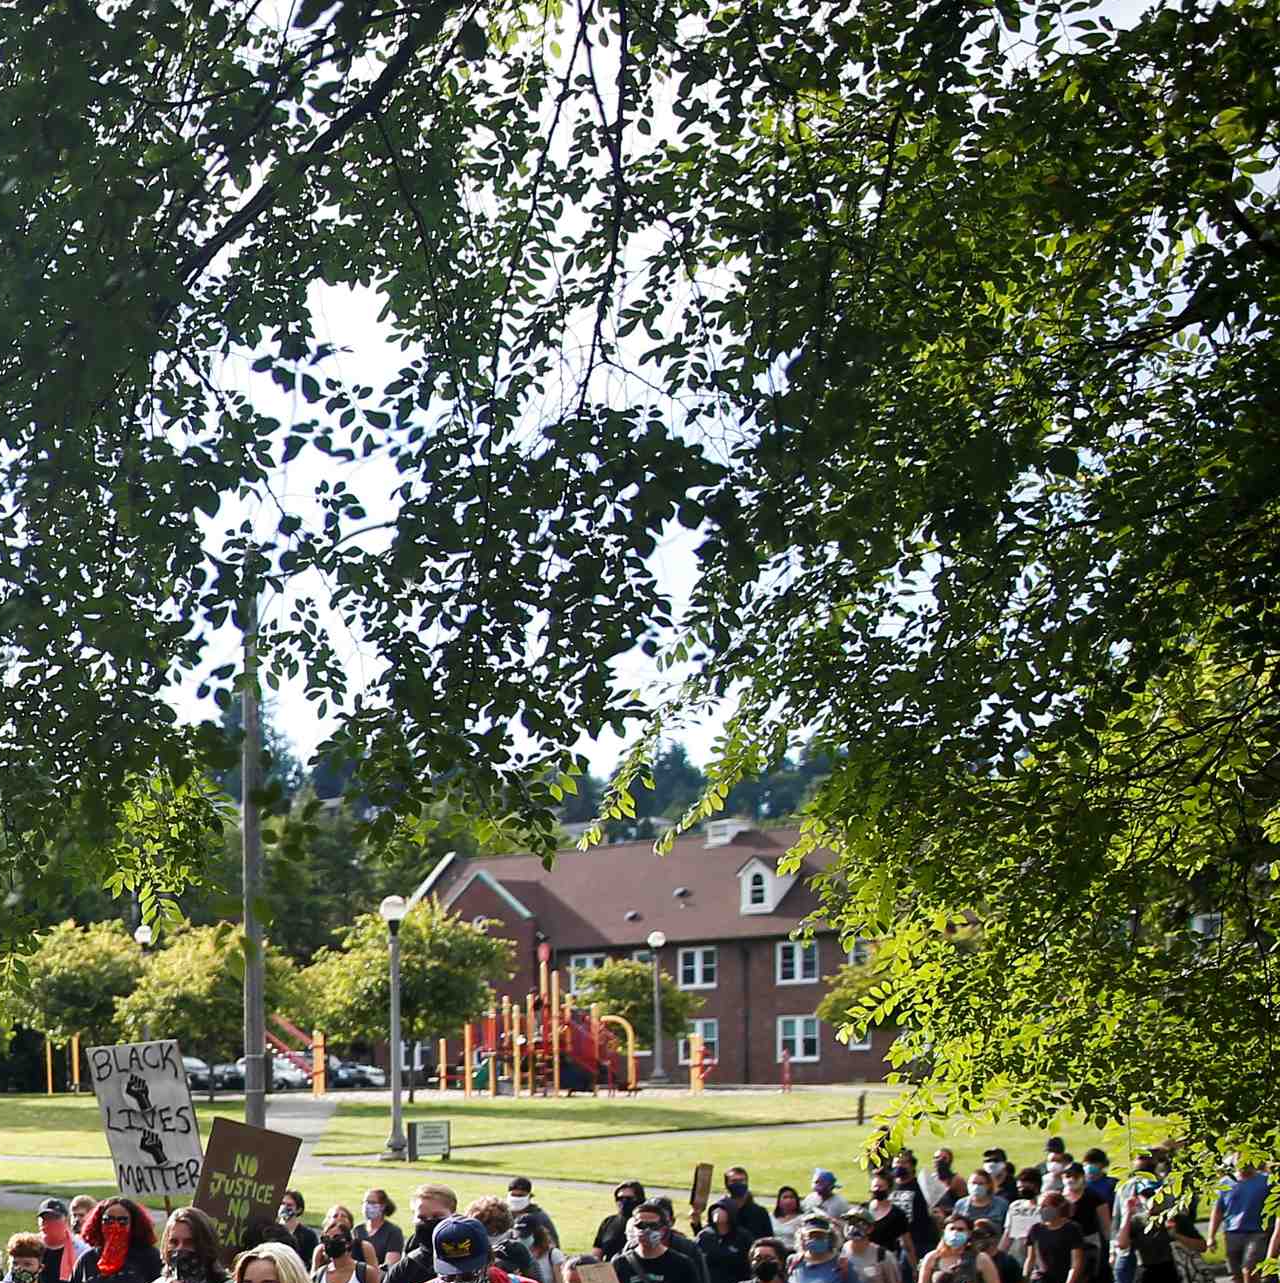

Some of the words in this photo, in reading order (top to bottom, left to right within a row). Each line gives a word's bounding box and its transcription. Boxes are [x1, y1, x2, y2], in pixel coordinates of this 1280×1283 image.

[92, 1043, 179, 1081] BLACK
[106, 1105, 192, 1134] LIVES
[118, 1158, 200, 1193] MATTER
[234, 1153, 259, 1176] NO
[209, 1171, 275, 1204] JUSTICE
[227, 1199, 251, 1219] NO
